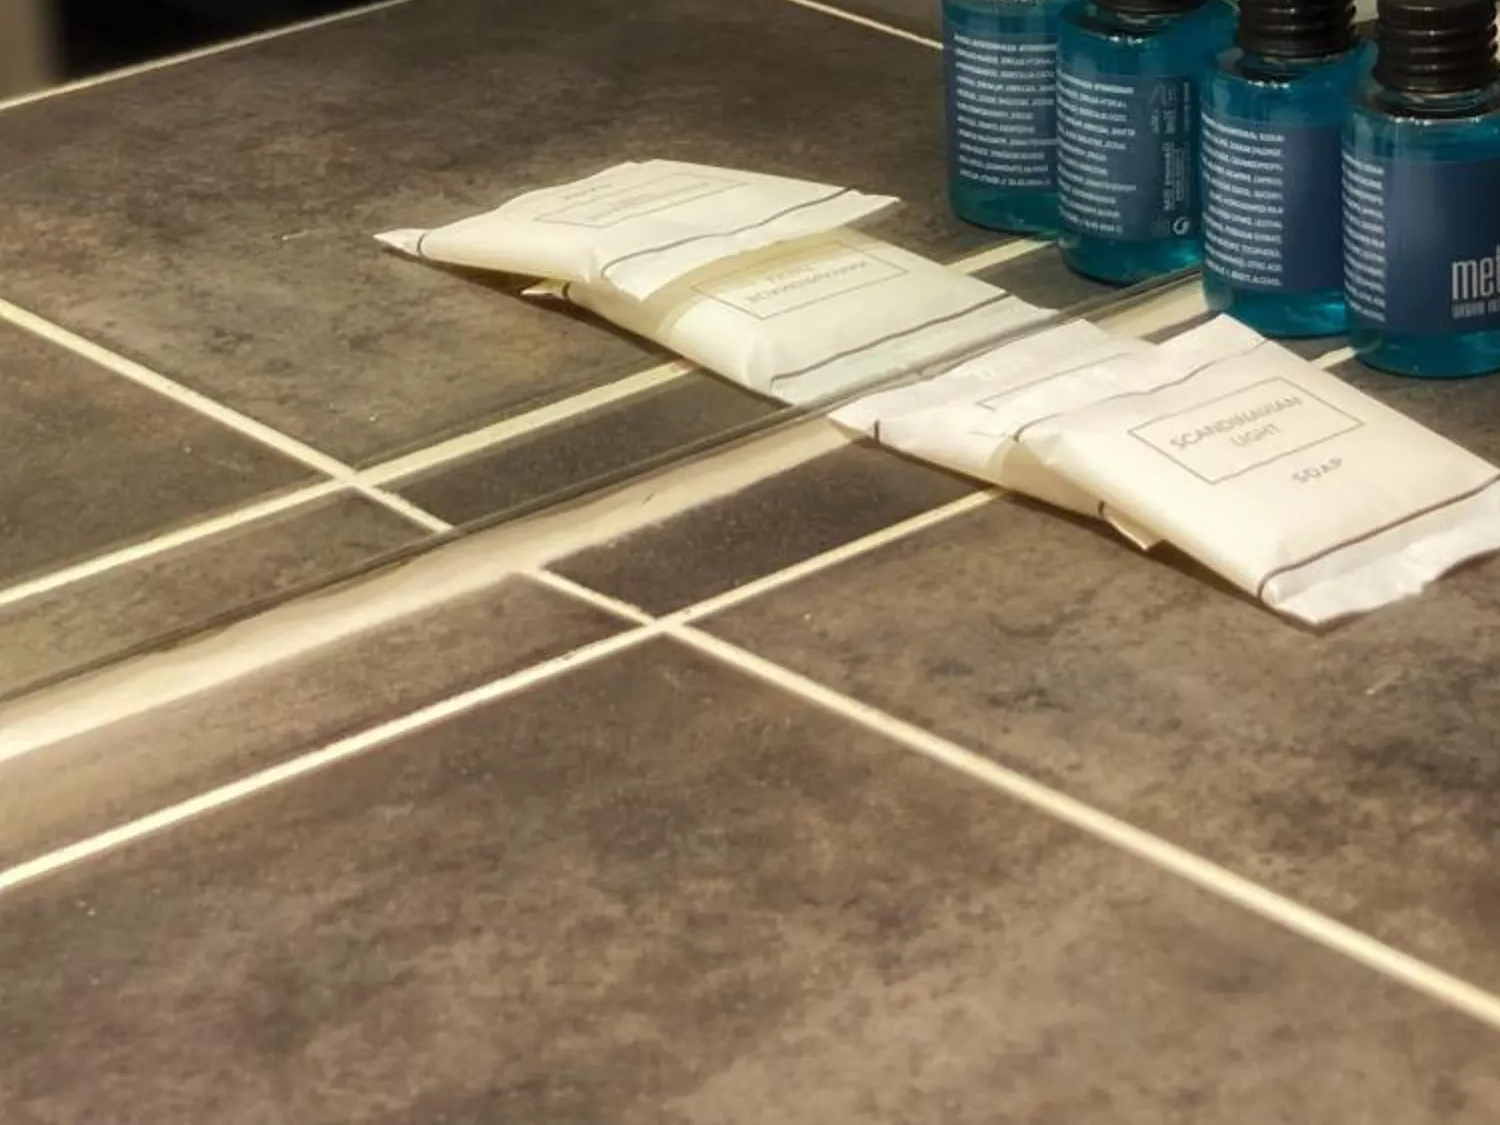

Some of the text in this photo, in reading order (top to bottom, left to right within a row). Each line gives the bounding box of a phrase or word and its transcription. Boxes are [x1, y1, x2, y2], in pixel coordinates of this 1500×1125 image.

[1169, 396, 1303, 450] SCANDINAVIAN
[1229, 423, 1281, 448] LIGHT
[1292, 457, 1342, 483] SOAP
